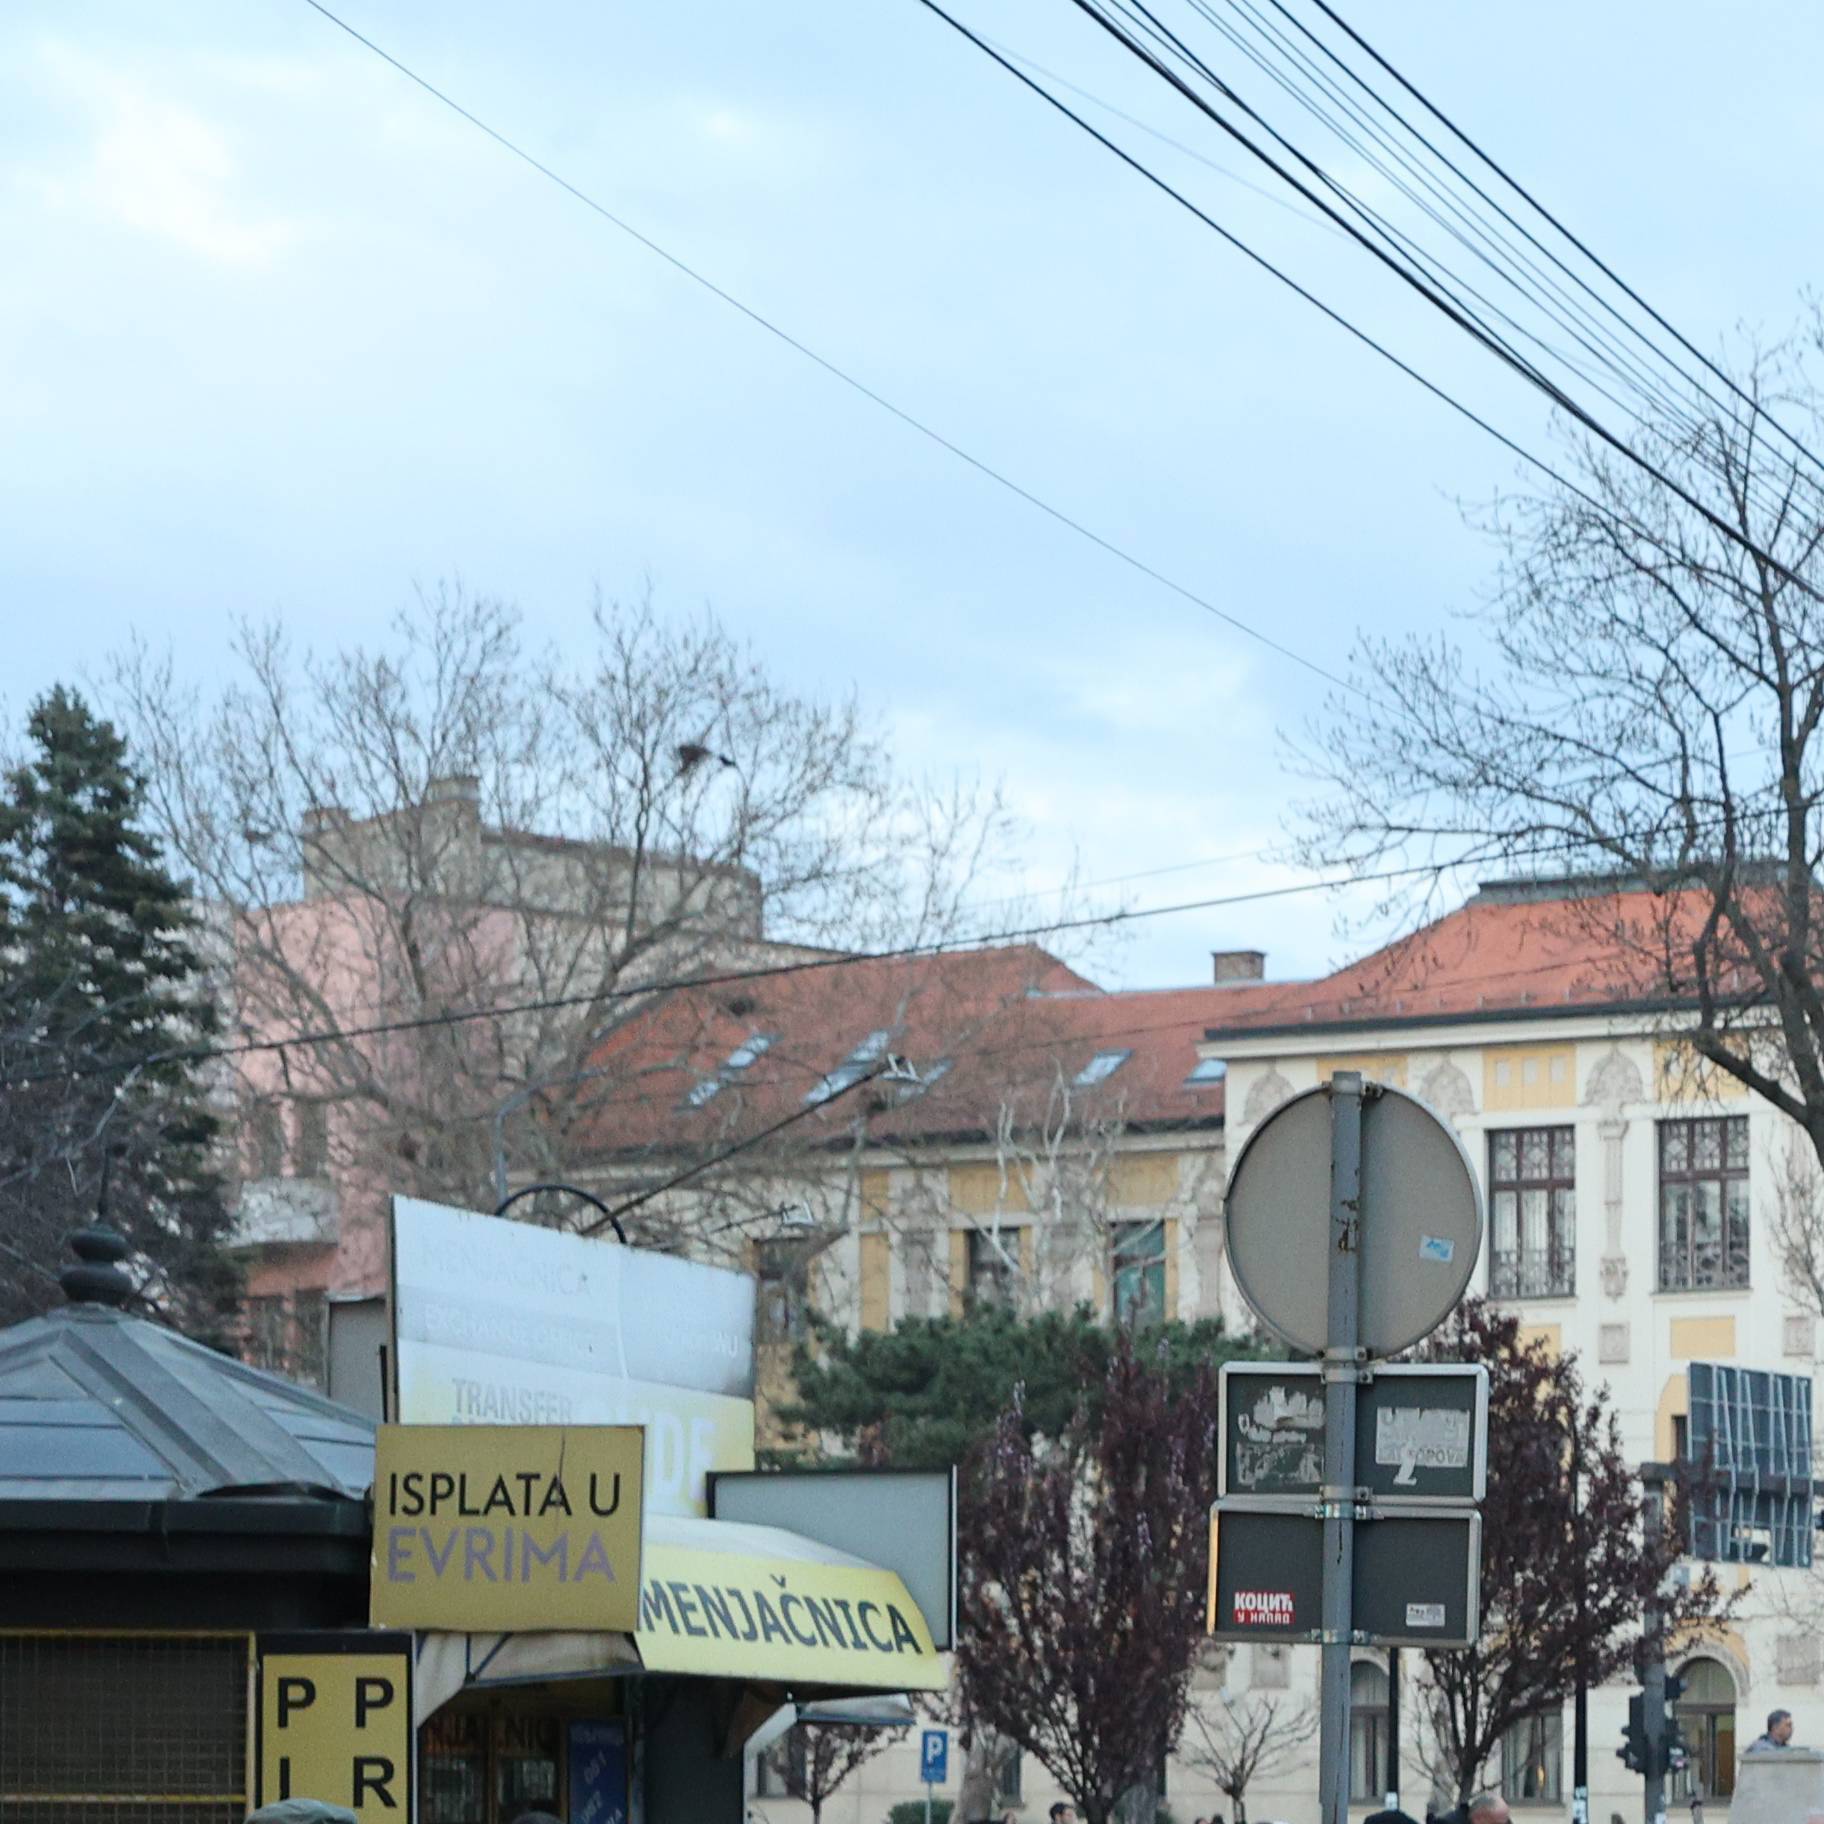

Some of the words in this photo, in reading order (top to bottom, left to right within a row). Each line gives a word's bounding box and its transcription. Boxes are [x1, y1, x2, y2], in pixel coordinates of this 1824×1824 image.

[389, 1472, 573, 1517] ISPLATA
[589, 1473, 621, 1517] U
[386, 1526, 617, 1584] EVRIMA
[642, 1573, 924, 1656] MENJAČNICA
[1234, 1591, 1293, 1614] КОЦИЋ
[1237, 1611, 1245, 1624] У
[1250, 1611, 1290, 1625] НАПАД
